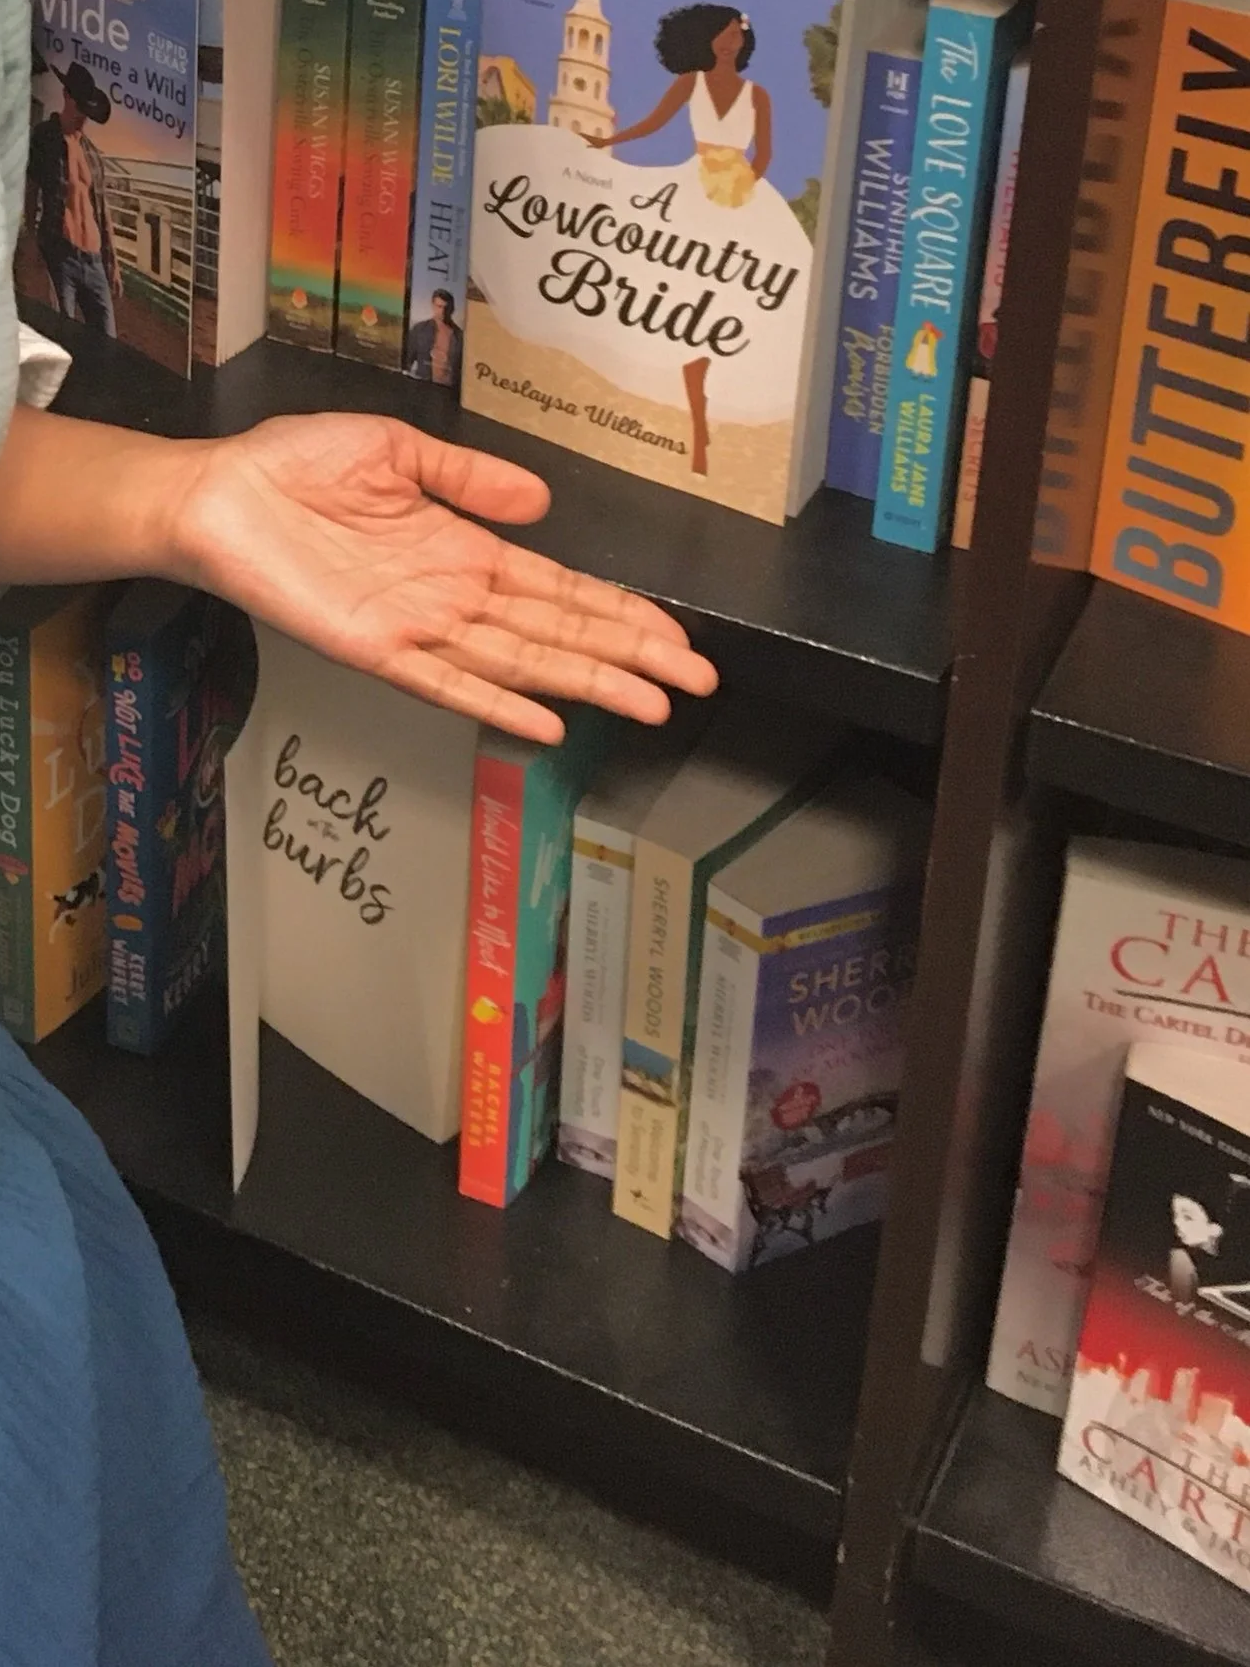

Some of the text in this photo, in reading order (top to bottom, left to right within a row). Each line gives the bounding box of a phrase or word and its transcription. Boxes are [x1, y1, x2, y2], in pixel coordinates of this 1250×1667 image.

[42, 26, 187, 108] To Tame a Wild
[148, 46, 188, 76] TEXAS
[431, 26, 461, 186] LORI WILDE
[110, 81, 187, 140] Cowboy
[308, 63, 331, 200] SUSAN WIGGS
[378, 78, 403, 215] SUSAN WIGGS
[289, 137, 309, 192] Sewing
[358, 154, 379, 207] Sewing
[575, 170, 614, 190] Novel
[629, 182, 679, 223] A
[910, 32, 980, 315] The LOVE SQUARE
[427, 200, 453, 282] HEAT
[483, 174, 801, 312] Lowcountry
[850, 137, 895, 302] WILLIAMS
[537, 248, 751, 358] Bride
[474, 361, 690, 456] Preslaysa Williams
[868, 324, 896, 436] FORBIDDEN
[890, 393, 936, 510] LAURA JANE WILLIAMS
[109, 688, 148, 907] NOT LIKE THE MOVIES
[274, 734, 391, 841] back
[262, 797, 396, 926] burbs
[472, 794, 518, 979] Would Like Meet
[110, 938, 131, 1006] WINFREY
[127, 953, 147, 1001] KERRY
[644, 876, 671, 1039] SHERRYL WOODS
[1110, 935, 1234, 1005] CA
[1082, 989, 1219, 1042] THE CARTEL
[467, 1051, 500, 1149] RACHEL WINTERS
[649, 1118, 666, 1185] Welcome
[1078, 1454, 1199, 1535] ASHLEY &
